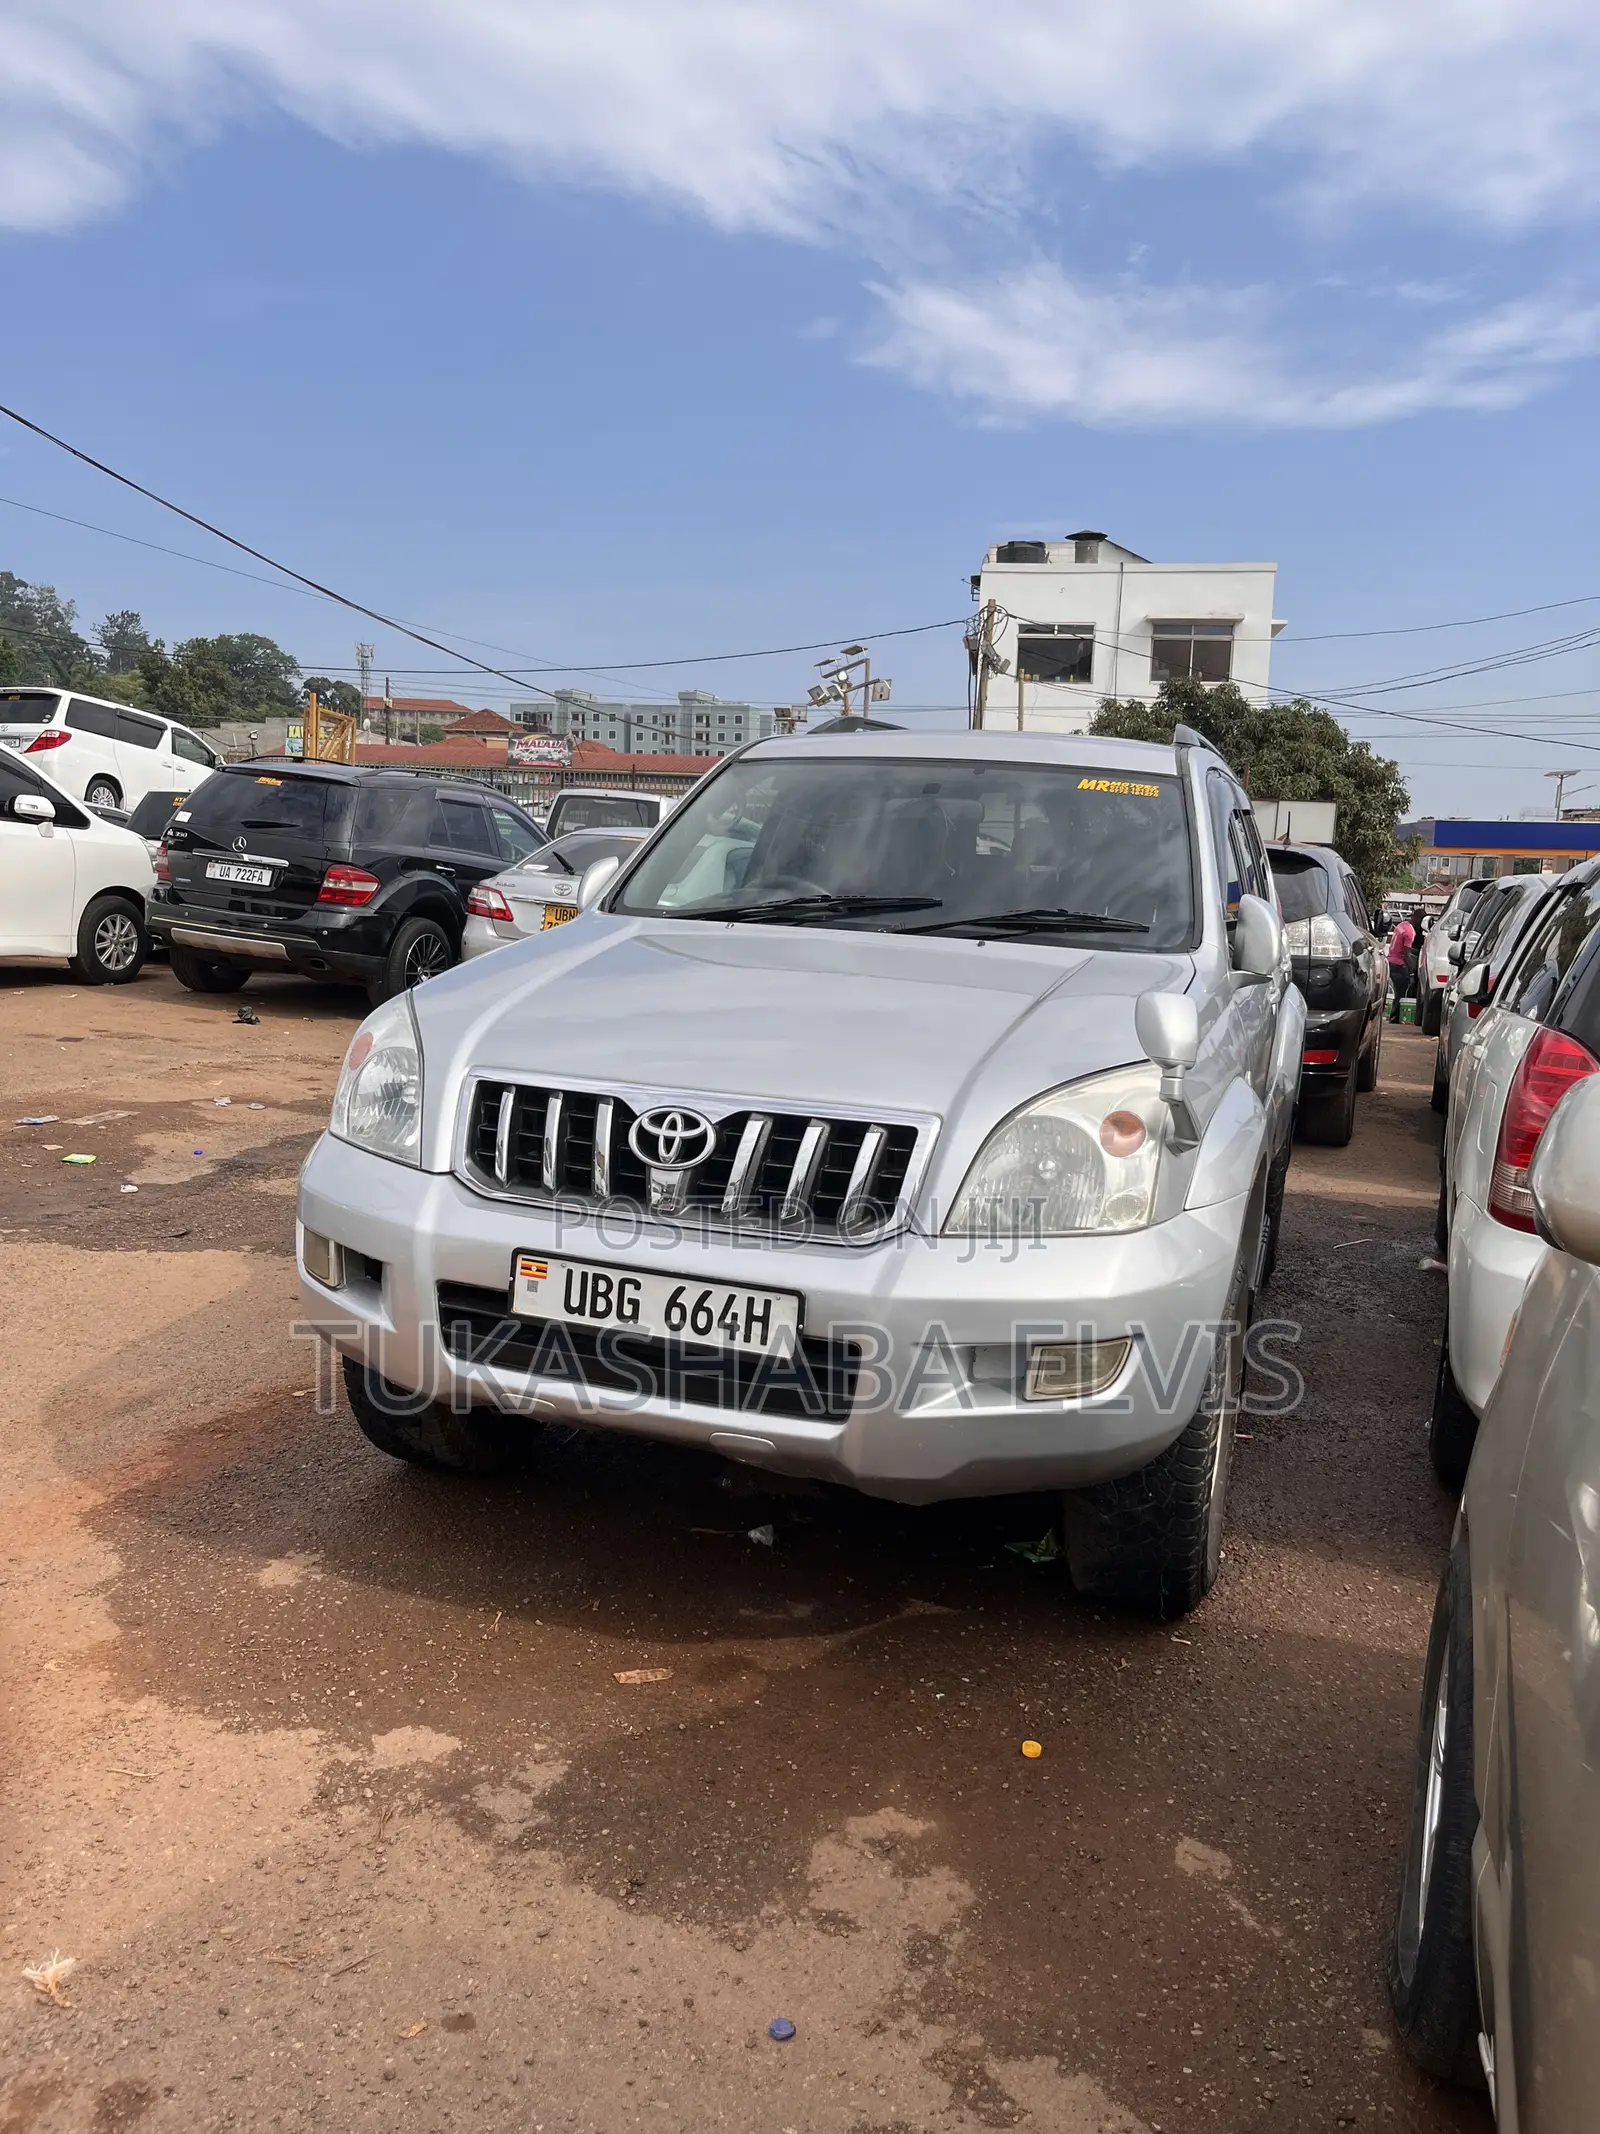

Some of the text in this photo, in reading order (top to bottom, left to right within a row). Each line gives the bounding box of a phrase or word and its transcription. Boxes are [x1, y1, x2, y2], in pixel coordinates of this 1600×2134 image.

[1077, 778, 1109, 792] MR
[219, 865, 264, 883] UA 722FA
[554, 908, 577, 921] UBN
[563, 1267, 772, 1346] UBG 664H
